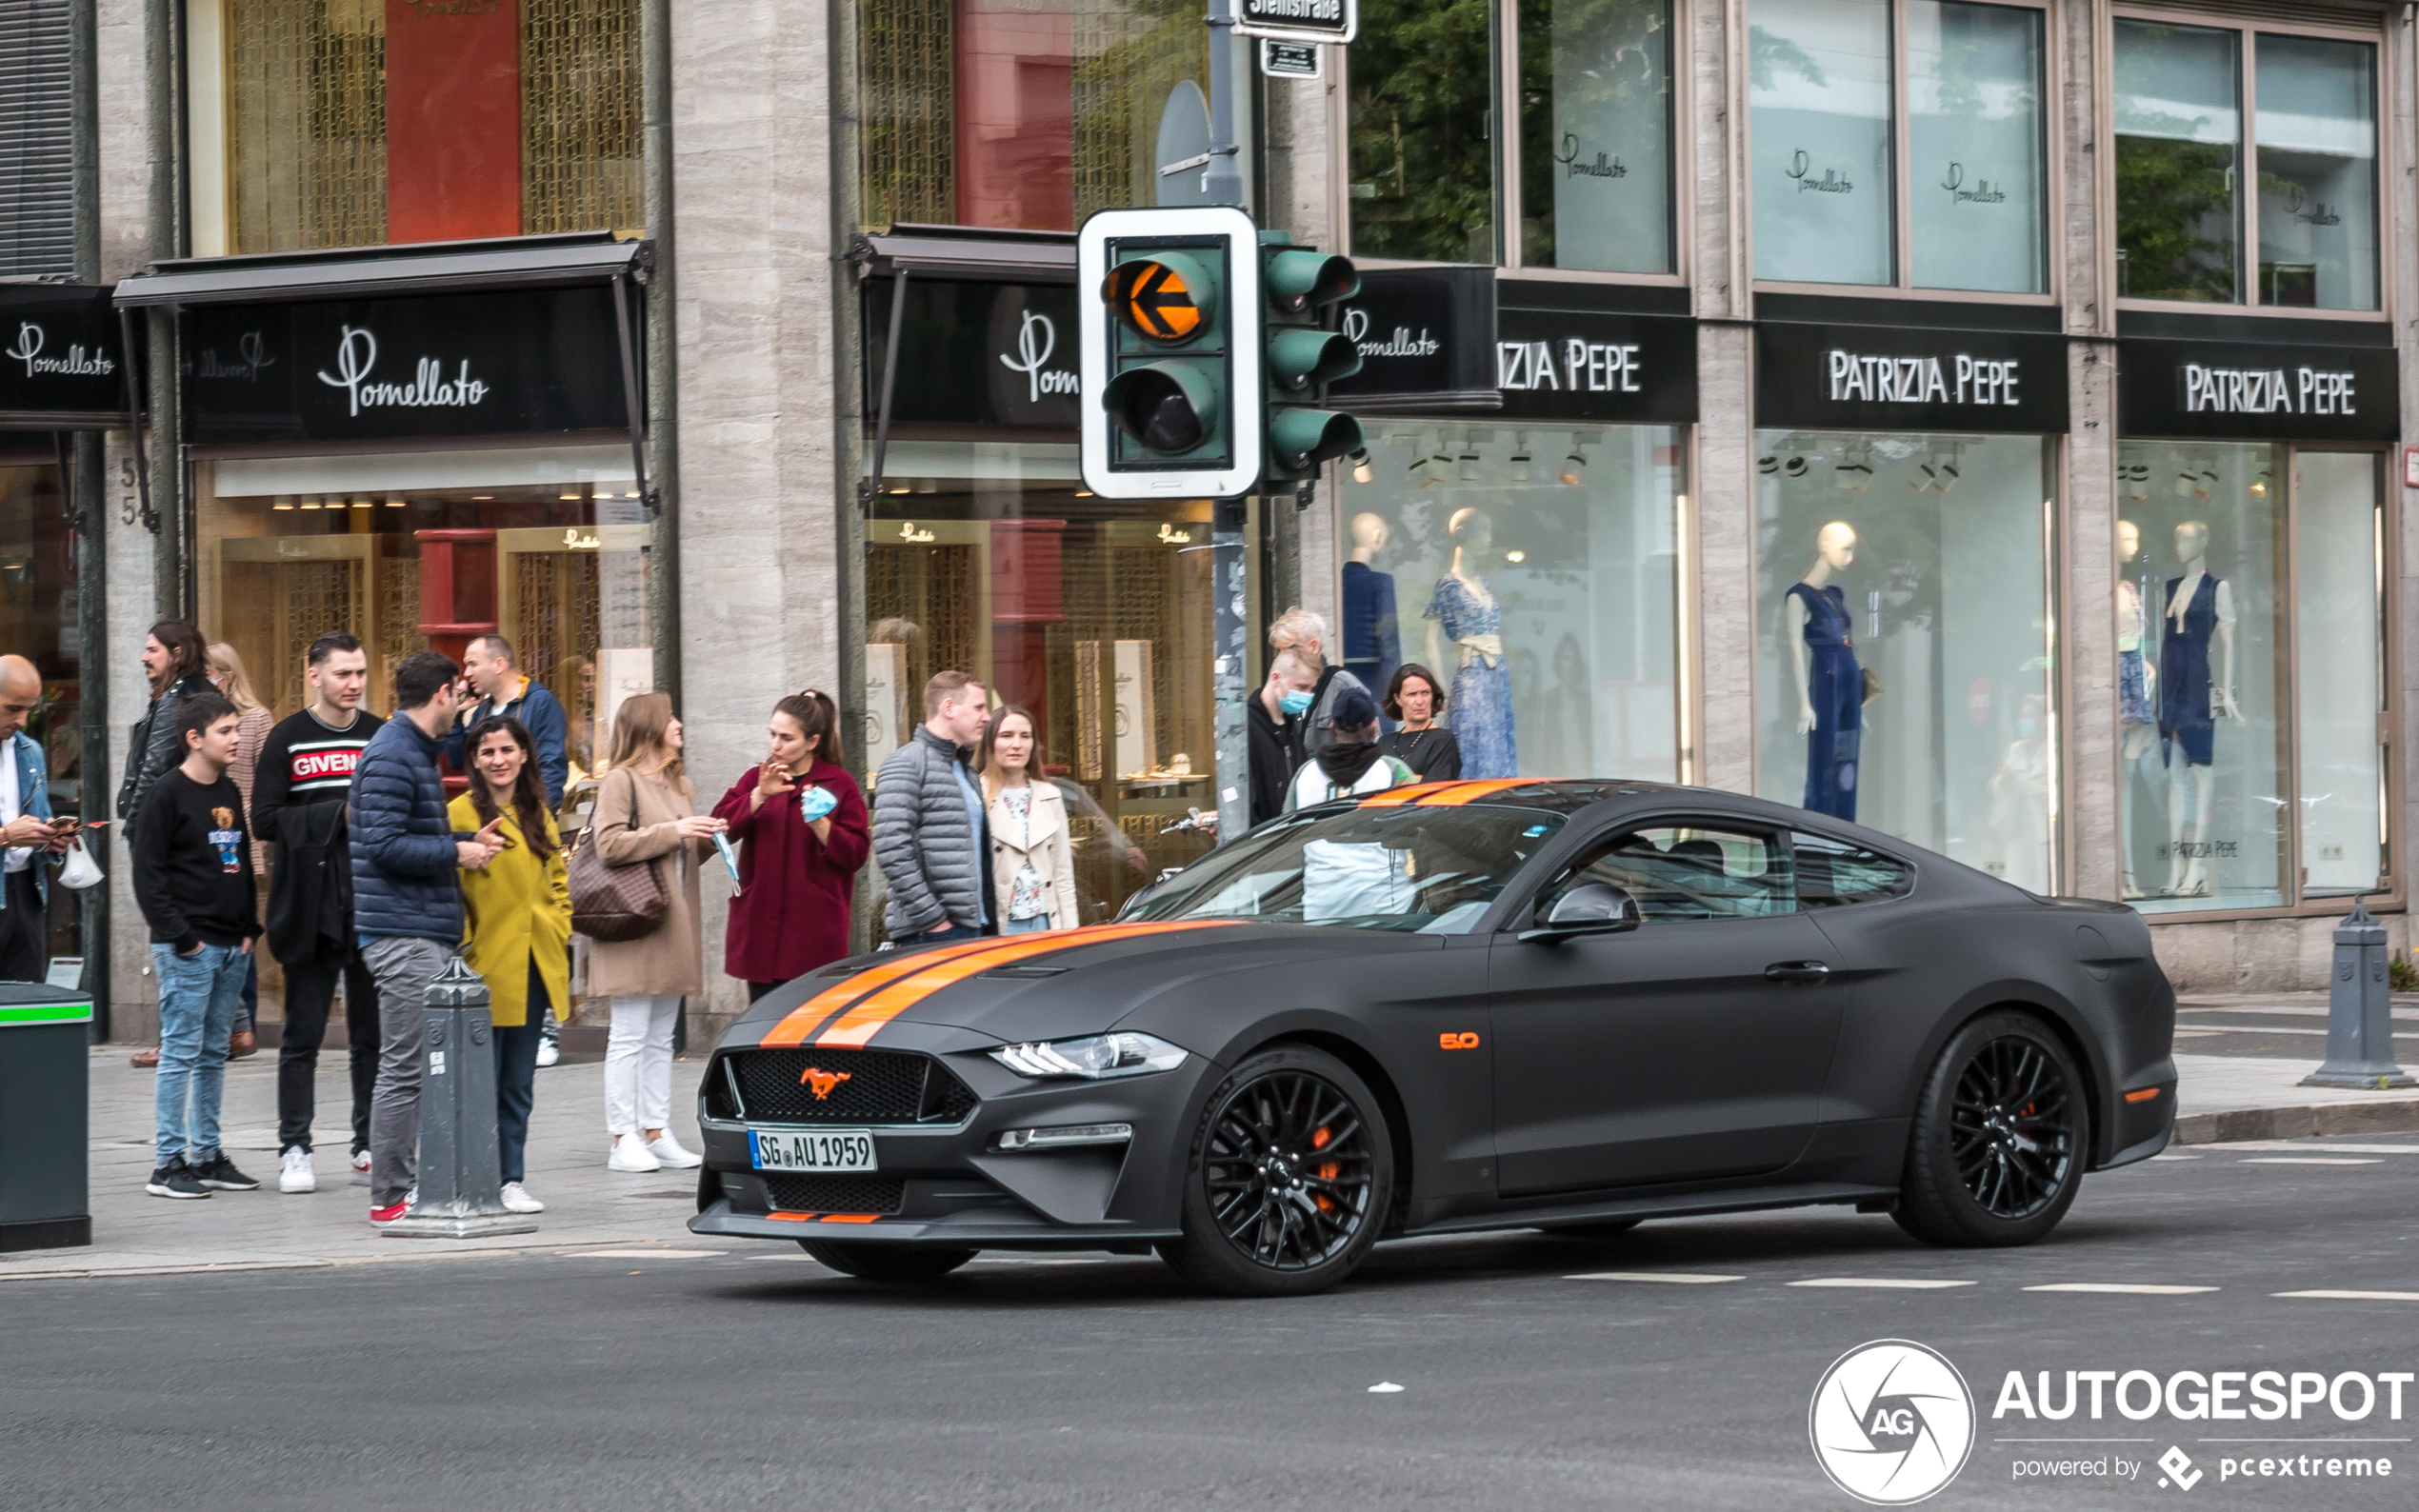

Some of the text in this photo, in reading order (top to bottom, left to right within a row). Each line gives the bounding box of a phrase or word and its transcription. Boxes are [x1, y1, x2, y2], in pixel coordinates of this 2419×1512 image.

[5, 321, 115, 378] Pomellato
[1342, 307, 1440, 357] Pomellato
[317, 325, 490, 416] Pomellato
[1496, 338, 1640, 392] IZIA PEPE
[1829, 349, 2019, 406] PATRIZIA PEPE
[2186, 364, 2356, 415] PATRIZIA PEPE
[292, 753, 359, 777] GIVEN
[759, 1136, 870, 1167] SG AU 1959
